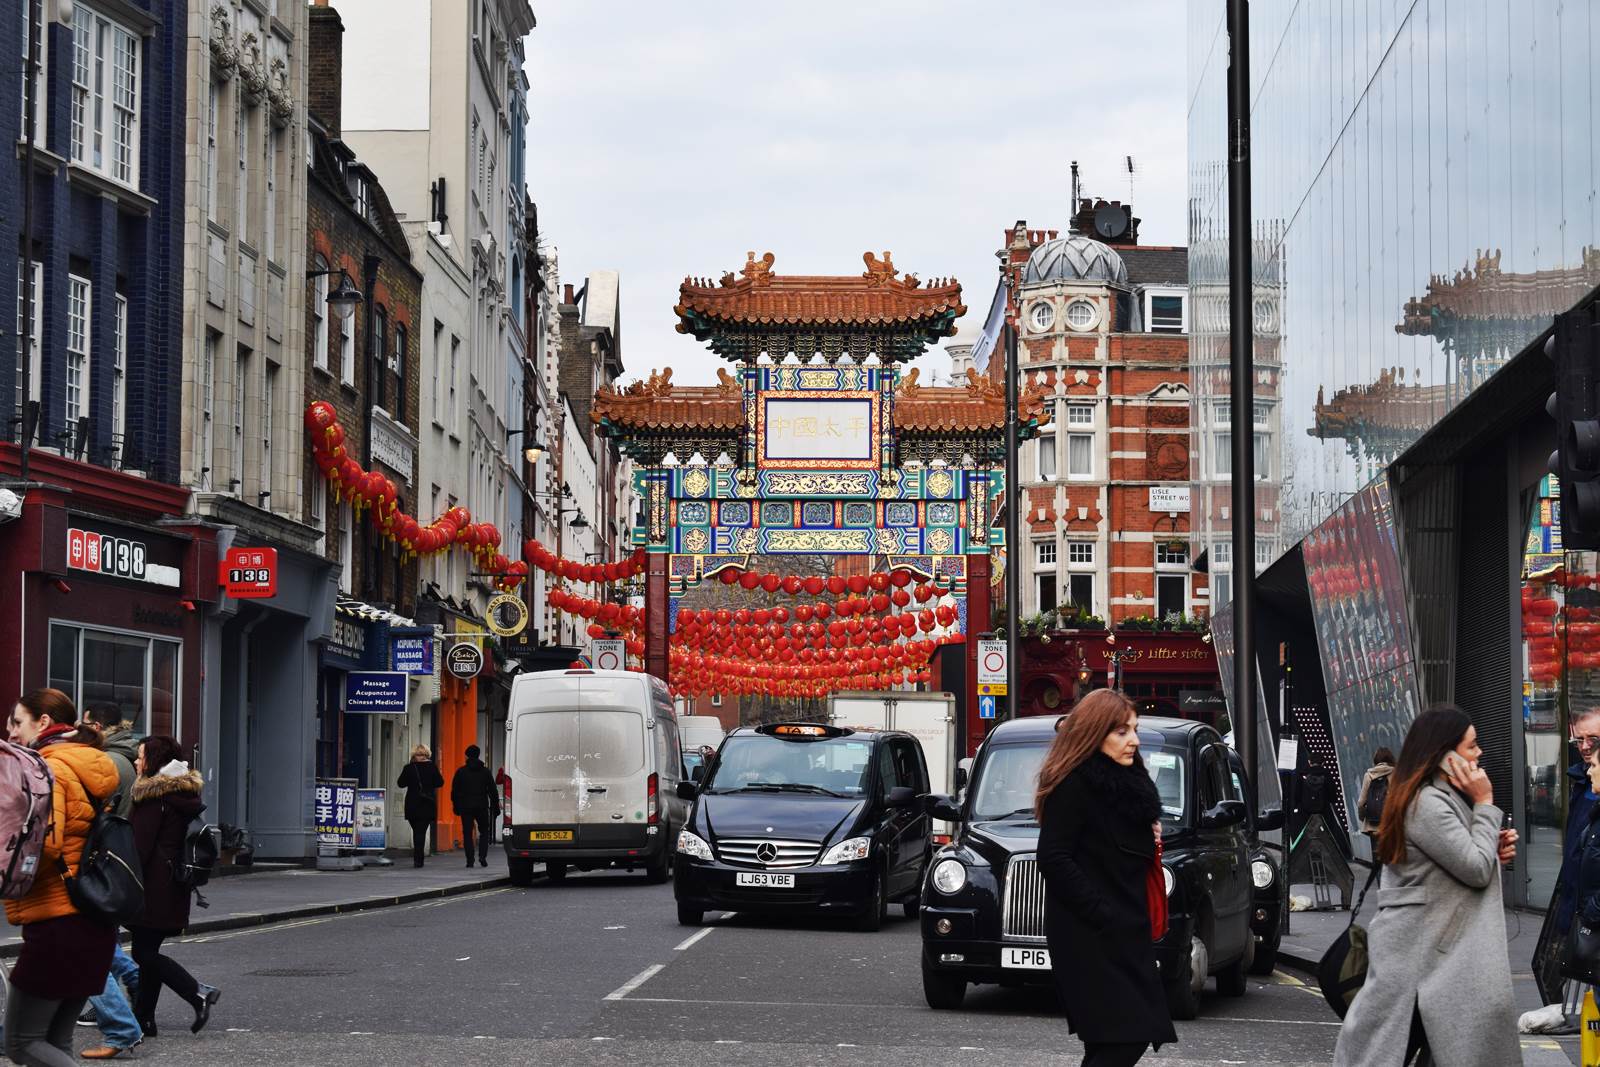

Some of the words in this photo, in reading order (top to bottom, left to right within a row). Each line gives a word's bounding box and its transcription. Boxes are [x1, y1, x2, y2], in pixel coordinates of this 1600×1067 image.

[230, 570, 268, 582] 138
[495, 628, 516, 636] LONDON
[396, 651, 423, 659] MASSAGE
[1181, 648, 1209, 659] sister
[363, 680, 390, 688] Massage
[356, 689, 397, 697] Acupuncture
[546, 754, 577, 762] CLEAN
[315, 787, 354, 806] 电脑
[315, 806, 354, 824] 手机
[741, 873, 768, 885] LJ63
[770, 874, 791, 885] VBE
[1011, 950, 1046, 966] LP16
